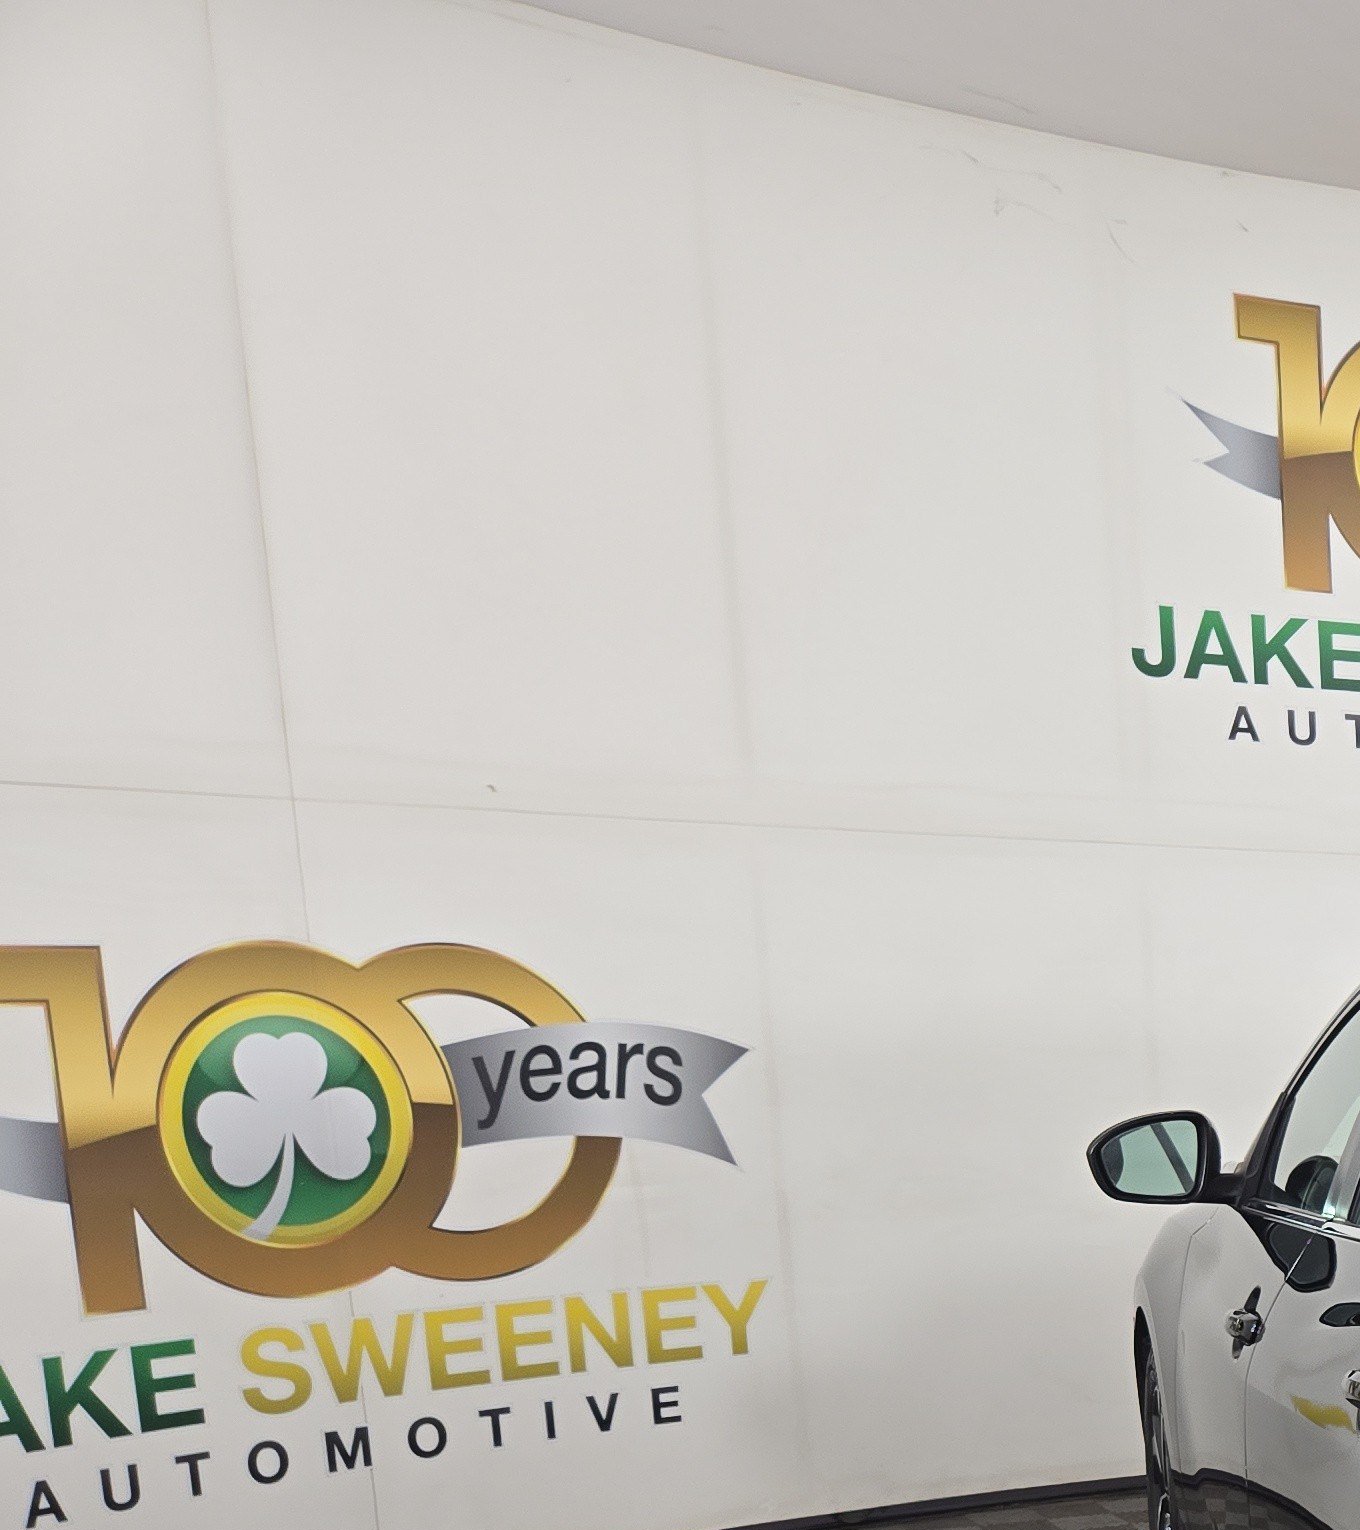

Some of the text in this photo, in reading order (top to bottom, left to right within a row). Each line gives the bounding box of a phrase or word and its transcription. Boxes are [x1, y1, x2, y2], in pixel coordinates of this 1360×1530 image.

[0, 940, 684, 1315] 100 years
[0, 1280, 769, 1453] AKE SWEENEY
[25, 1386, 682, 1529] AUTOMOTIVE
